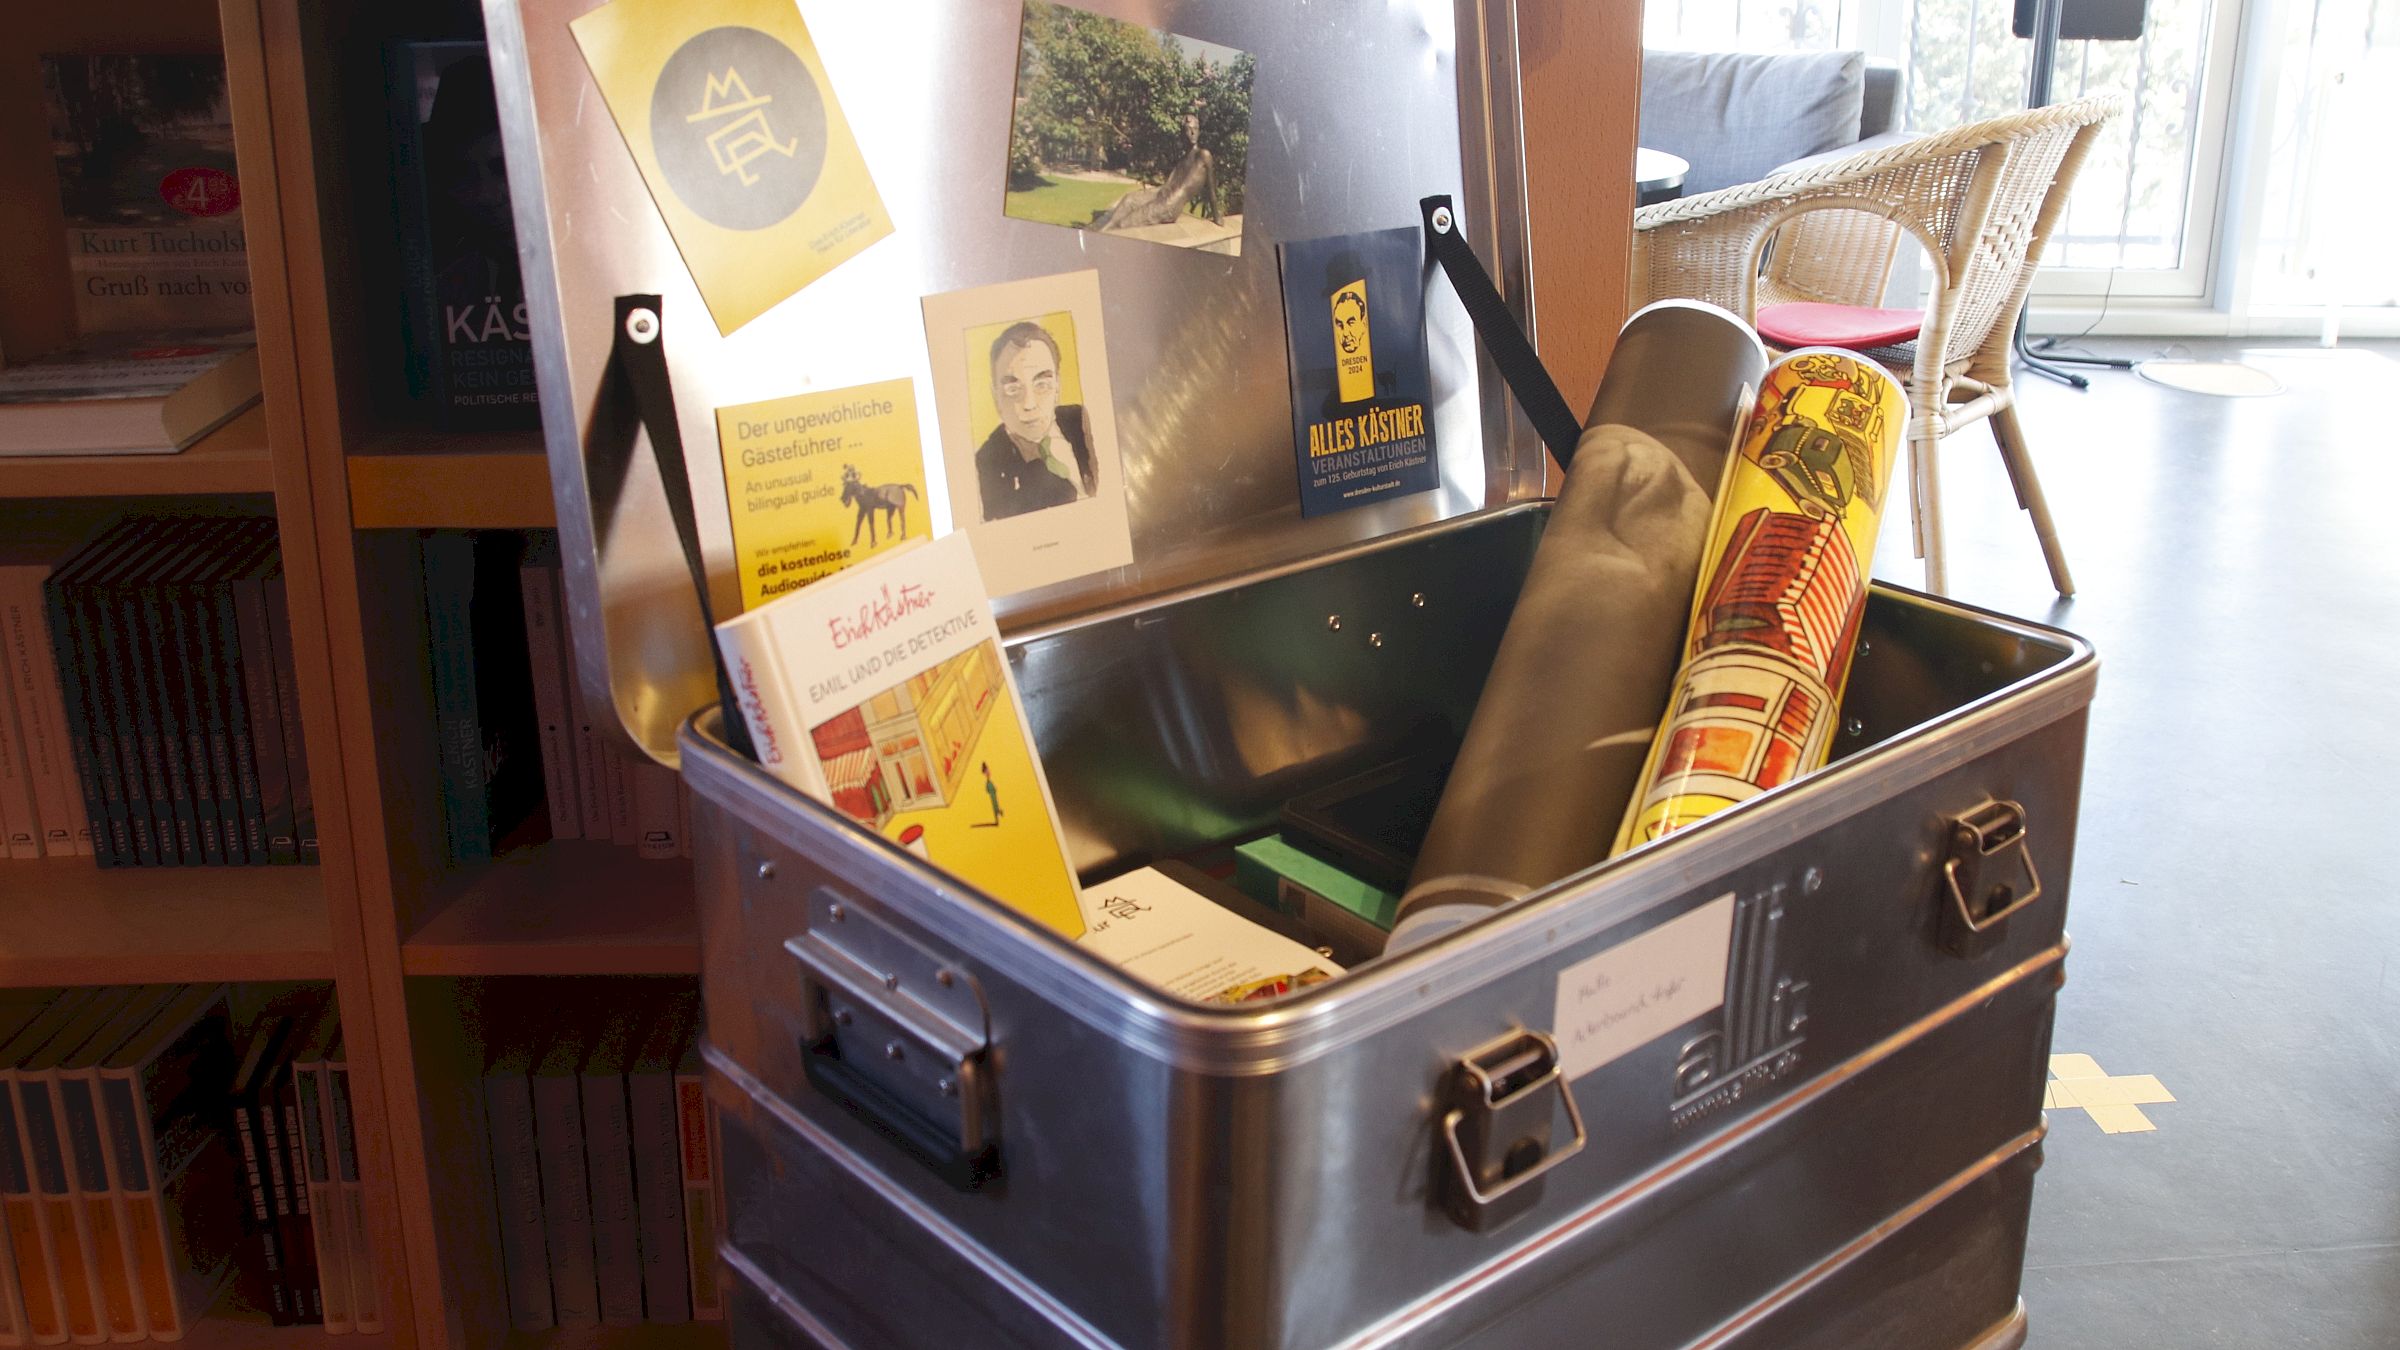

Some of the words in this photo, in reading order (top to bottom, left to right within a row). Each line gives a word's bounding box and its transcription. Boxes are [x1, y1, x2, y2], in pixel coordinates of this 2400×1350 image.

[81, 231, 138, 254] Kurt
[86, 274, 150, 297] Gruß
[158, 274, 212, 296] nach
[1341, 356, 1368, 367] DRESDEN
[453, 370, 499, 388] KEIN
[454, 392, 520, 407] POLITISCHE
[737, 420, 769, 441] Der
[1309, 418, 1355, 458] ALLES
[1357, 403, 1425, 448] KÄSTNER
[741, 436, 843, 468] Gästeführer
[1311, 437, 1427, 475] VERANSTALTUNGEN
[745, 480, 763, 495] An
[764, 470, 813, 492] unusual
[1313, 478, 1328, 488] zum
[1342, 466, 1377, 481] Geburtstag
[1377, 464, 1389, 474] von
[1388, 459, 1404, 471] Erich
[1404, 455, 1427, 468] Kästner
[747, 489, 800, 513] bilingual
[801, 484, 836, 505] guide
[757, 562, 778, 578] die
[780, 548, 852, 572] kostenlose
[760, 570, 833, 597] Audioguid
[808, 674, 849, 704] EMIL
[848, 656, 882, 685] UND
[882, 643, 908, 668] DIE
[907, 608, 979, 655] DETEKTIVE
[21, 658, 35, 692] ERICH
